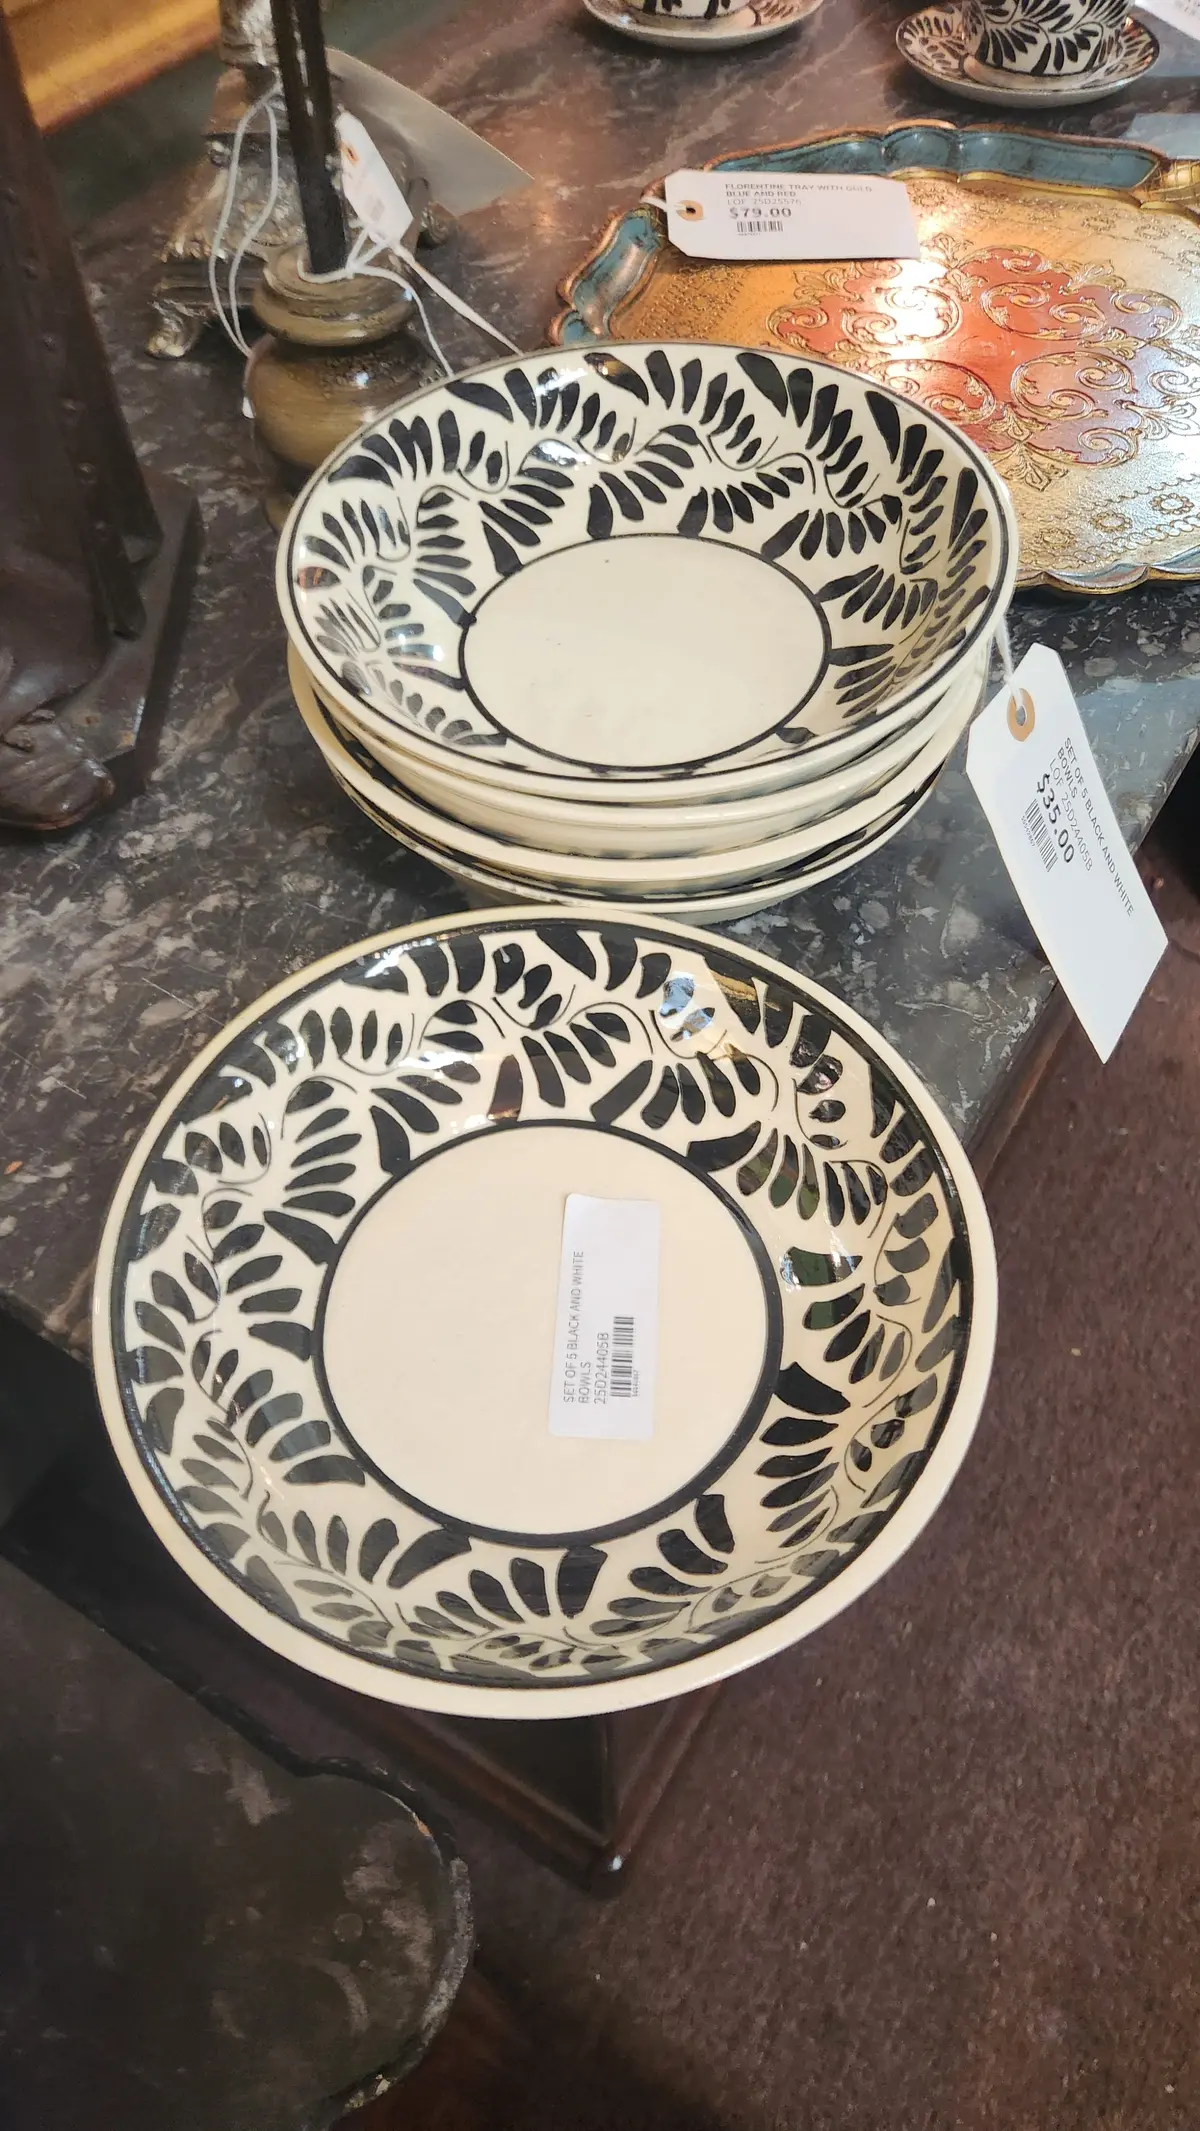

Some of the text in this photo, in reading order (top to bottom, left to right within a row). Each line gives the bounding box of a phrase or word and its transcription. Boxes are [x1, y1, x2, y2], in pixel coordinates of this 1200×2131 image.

[729, 207, 792, 219] $79.00
[1057, 747, 1078, 799] BOWLS
[1036, 773, 1075, 863] $35.00
[1050, 758, 1093, 872] LOF 25D24405B
[1064, 737, 1134, 916] SET OF 5 BLACK AND WHITE
[572, 1251, 584, 1287] WHITE
[570, 1288, 582, 1312] AND
[567, 1315, 580, 1351] BLACK
[565, 1362, 577, 1379] OF
[578, 1361, 591, 1404] BOWLS
[594, 1332, 609, 1405] 25D24405B
[563, 1381, 575, 1403] SET
